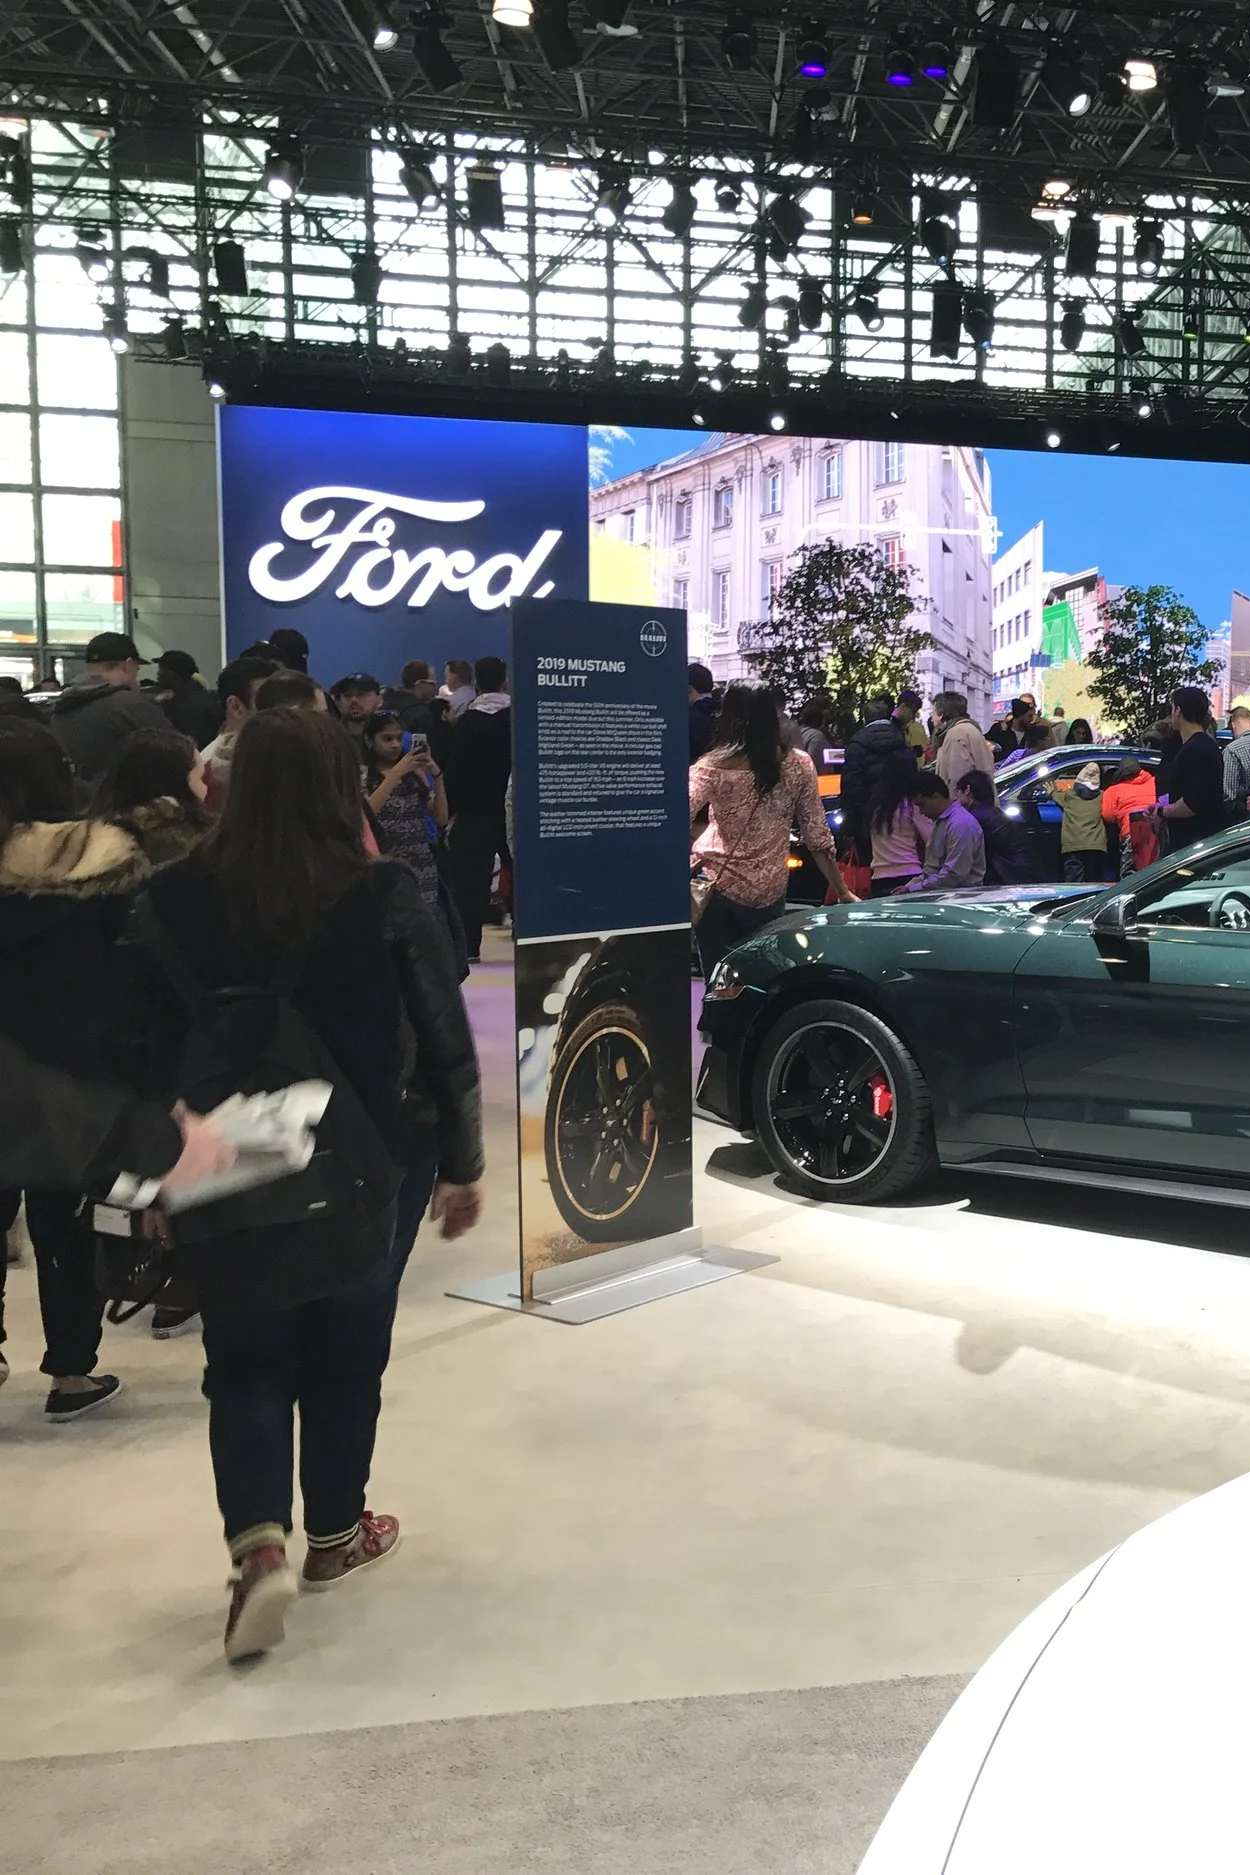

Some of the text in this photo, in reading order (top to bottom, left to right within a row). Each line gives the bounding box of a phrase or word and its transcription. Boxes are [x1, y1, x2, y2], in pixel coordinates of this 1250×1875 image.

[248, 486, 563, 611] Ford
[537, 656, 626, 672] 2019 MUSTANG
[538, 674, 588, 687] BULLITT
